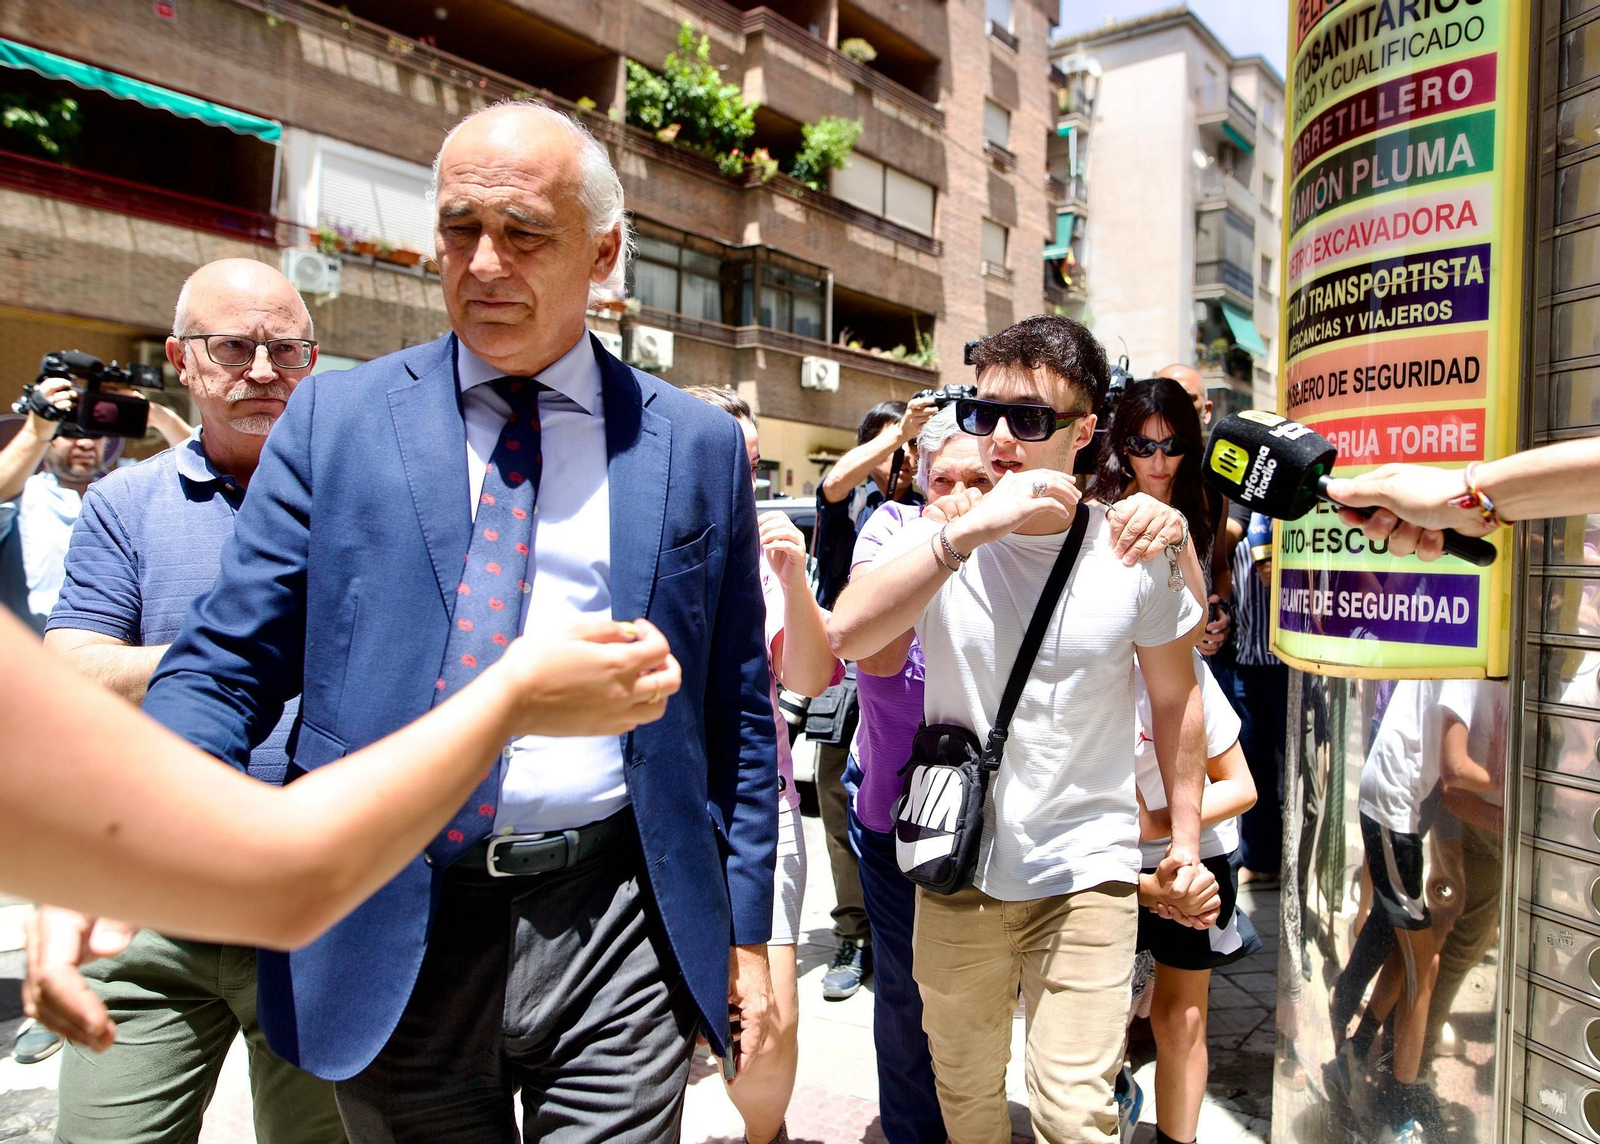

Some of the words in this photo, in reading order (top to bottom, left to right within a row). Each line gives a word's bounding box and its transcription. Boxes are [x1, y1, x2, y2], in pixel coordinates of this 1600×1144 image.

[1320, 73, 1329, 98] Y
[1331, 16, 1485, 90] CUALIFICADO
[1352, 133, 1476, 195] PLUMA
[1309, 255, 1485, 316] TRANSPORTISTA
[1345, 313, 1356, 334] Y
[1359, 300, 1453, 329] VIAJEROS
[1328, 370, 1349, 398] DE
[1353, 356, 1480, 393] SEGURIDAD
[1387, 423, 1478, 456] TORRE
[1241, 445, 1271, 502] Informa
[1253, 458, 1278, 500] Radio
[1313, 590, 1334, 616] DE
[1338, 591, 1470, 625] SEGURIDAD
